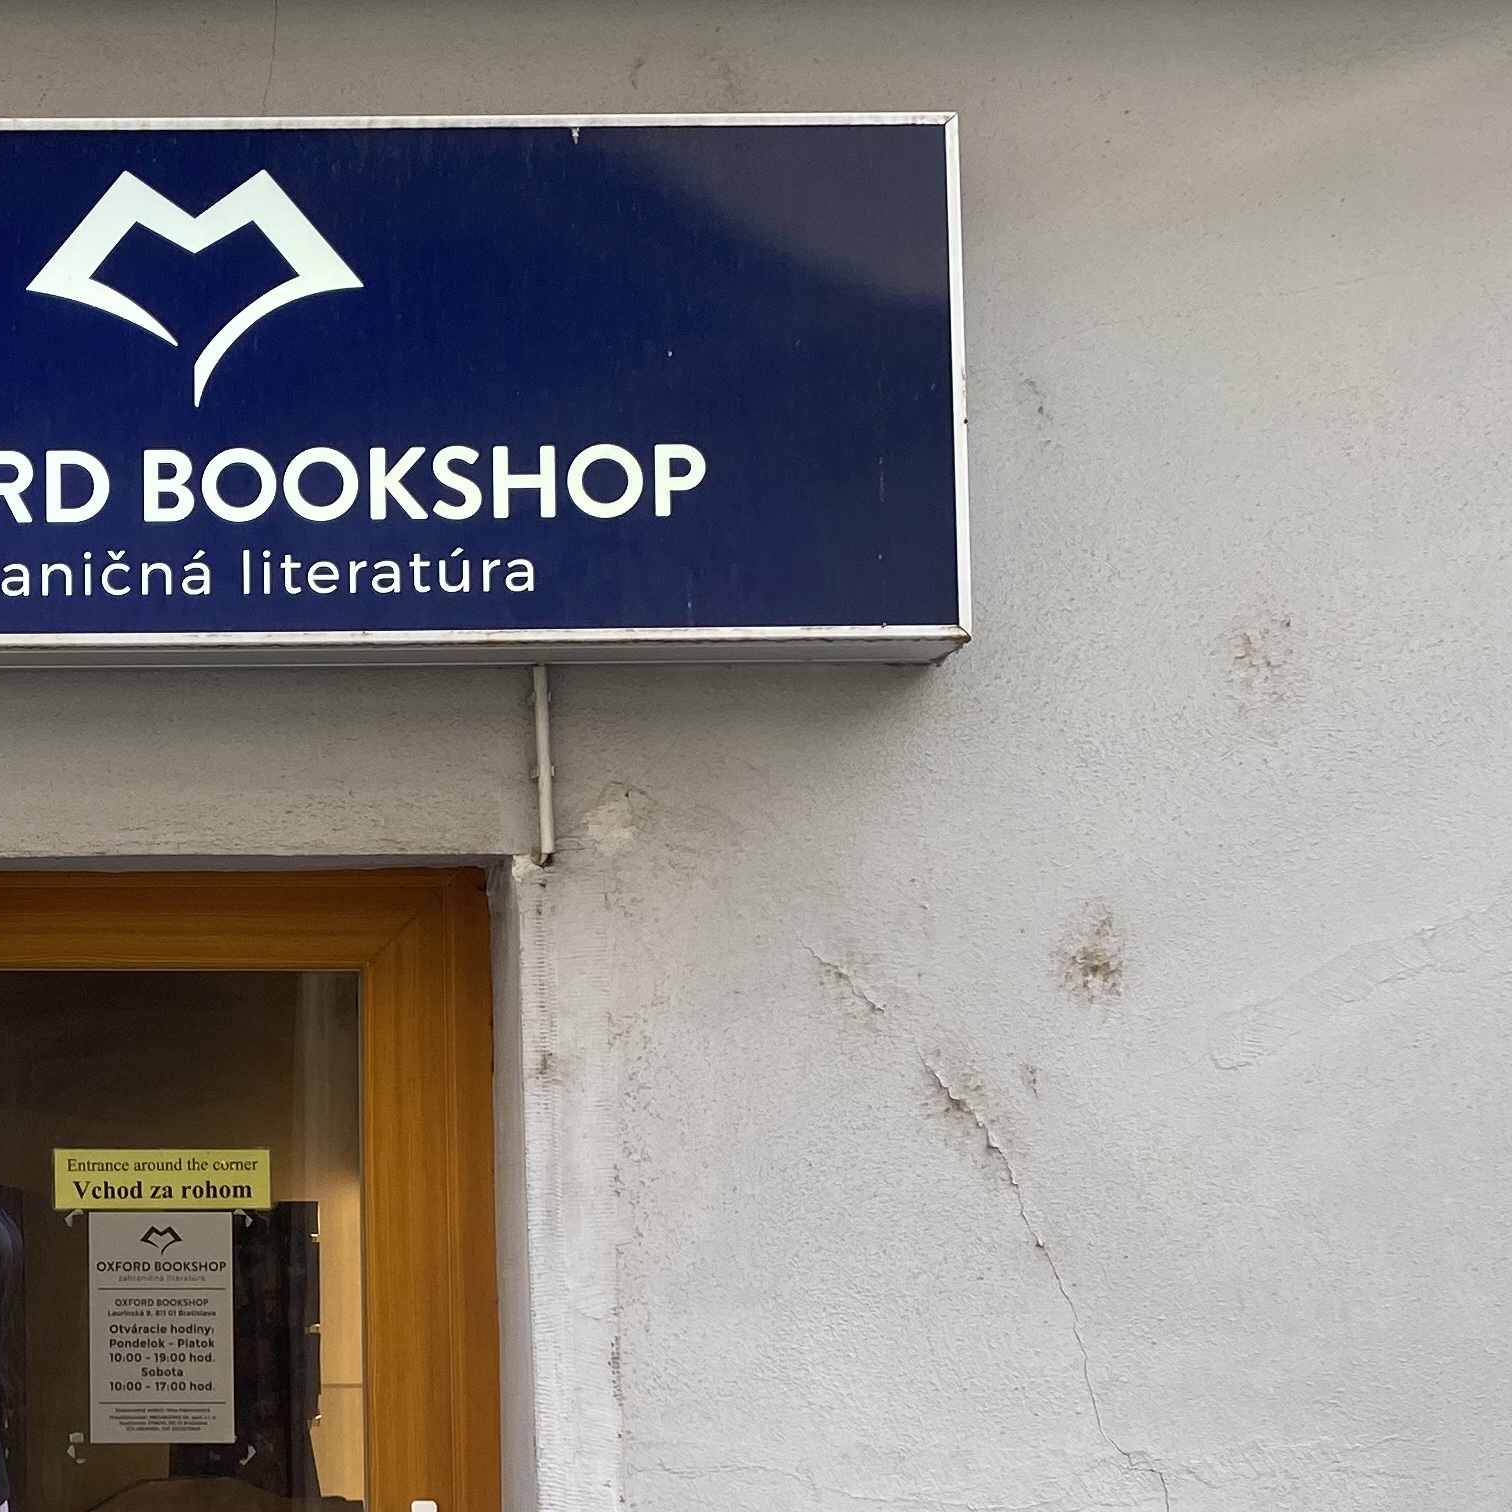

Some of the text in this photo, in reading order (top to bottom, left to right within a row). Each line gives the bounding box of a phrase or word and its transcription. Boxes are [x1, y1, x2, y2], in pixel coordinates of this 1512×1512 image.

[142, 443, 708, 524] BOOKSHOP
[240, 546, 537, 596] literatúra
[67, 1157, 258, 1172] Entrance around the corner
[73, 1180, 253, 1199] Vchod za rohom
[96, 1261, 227, 1272] OXFORD BOOKSHOP
[114, 1298, 209, 1307] OXFORD BOOKSHOP
[109, 1323, 168, 1335] Otváracie
[109, 1338, 166, 1349] Pondelok
[177, 1338, 215, 1349] Piatok
[109, 1352, 143, 1363] 10:00
[154, 1352, 187, 1363] 19:00
[189, 1352, 216, 1363] hod.
[141, 1366, 184, 1378] Sobota
[109, 1381, 143, 1392] 10:00
[155, 1381, 187, 1392] 17:00
[189, 1381, 216, 1392] hod.
